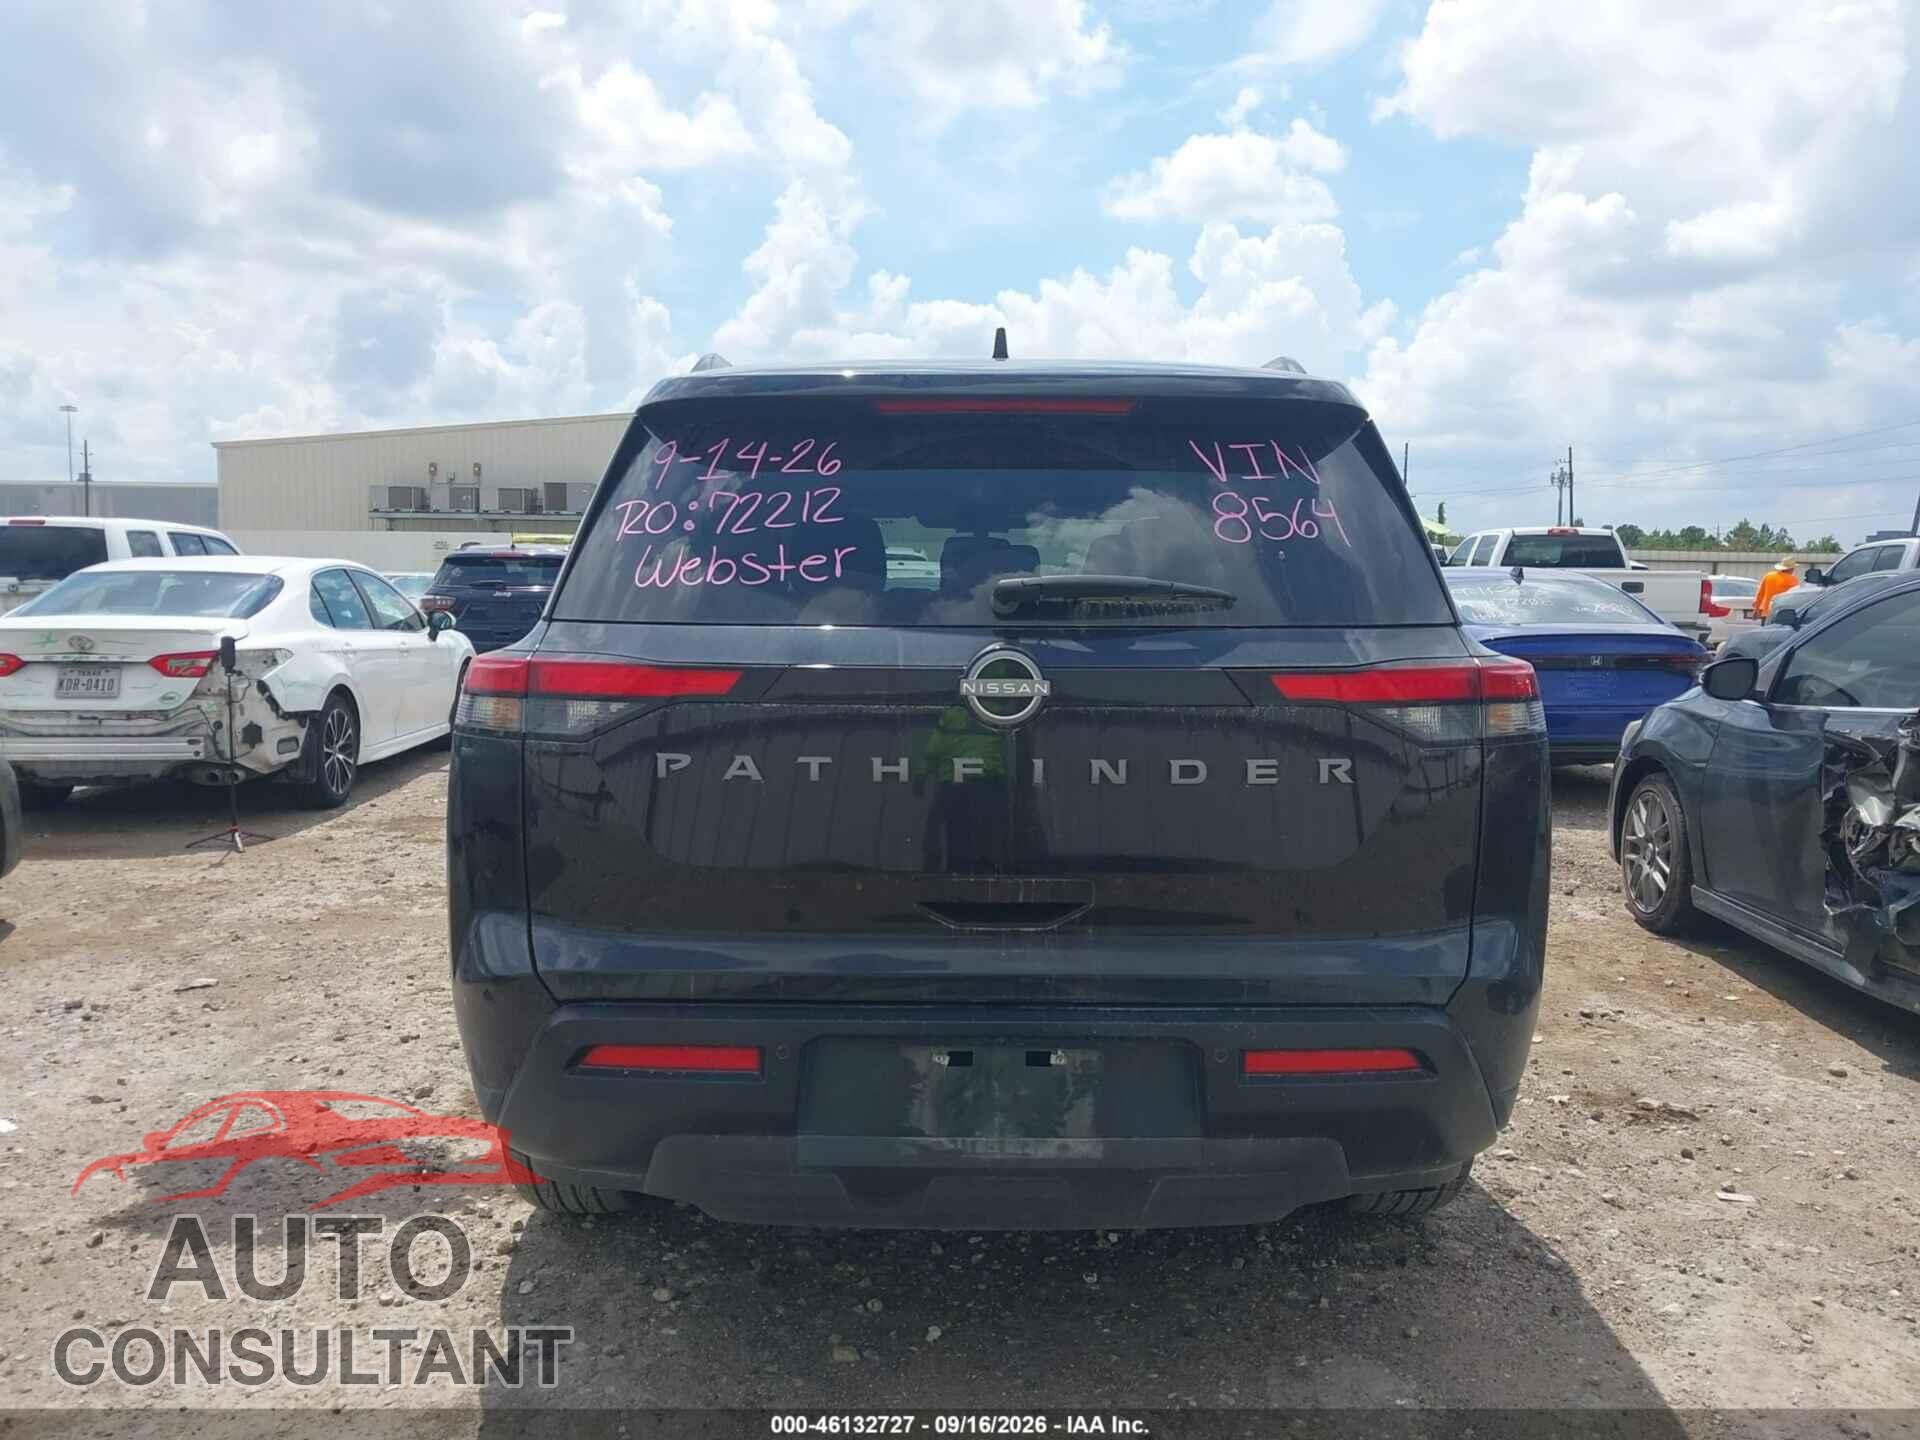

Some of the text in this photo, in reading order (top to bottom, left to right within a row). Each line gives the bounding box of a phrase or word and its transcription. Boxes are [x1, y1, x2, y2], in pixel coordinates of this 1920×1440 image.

[654, 438, 842, 489] 9-14-26
[1188, 439, 1320, 485] VIN
[1213, 492, 1352, 546] 8564
[634, 543, 856, 588] Webster
[961, 681, 1049, 694] NISSAN
[655, 751, 1354, 783] PATHFINDER
